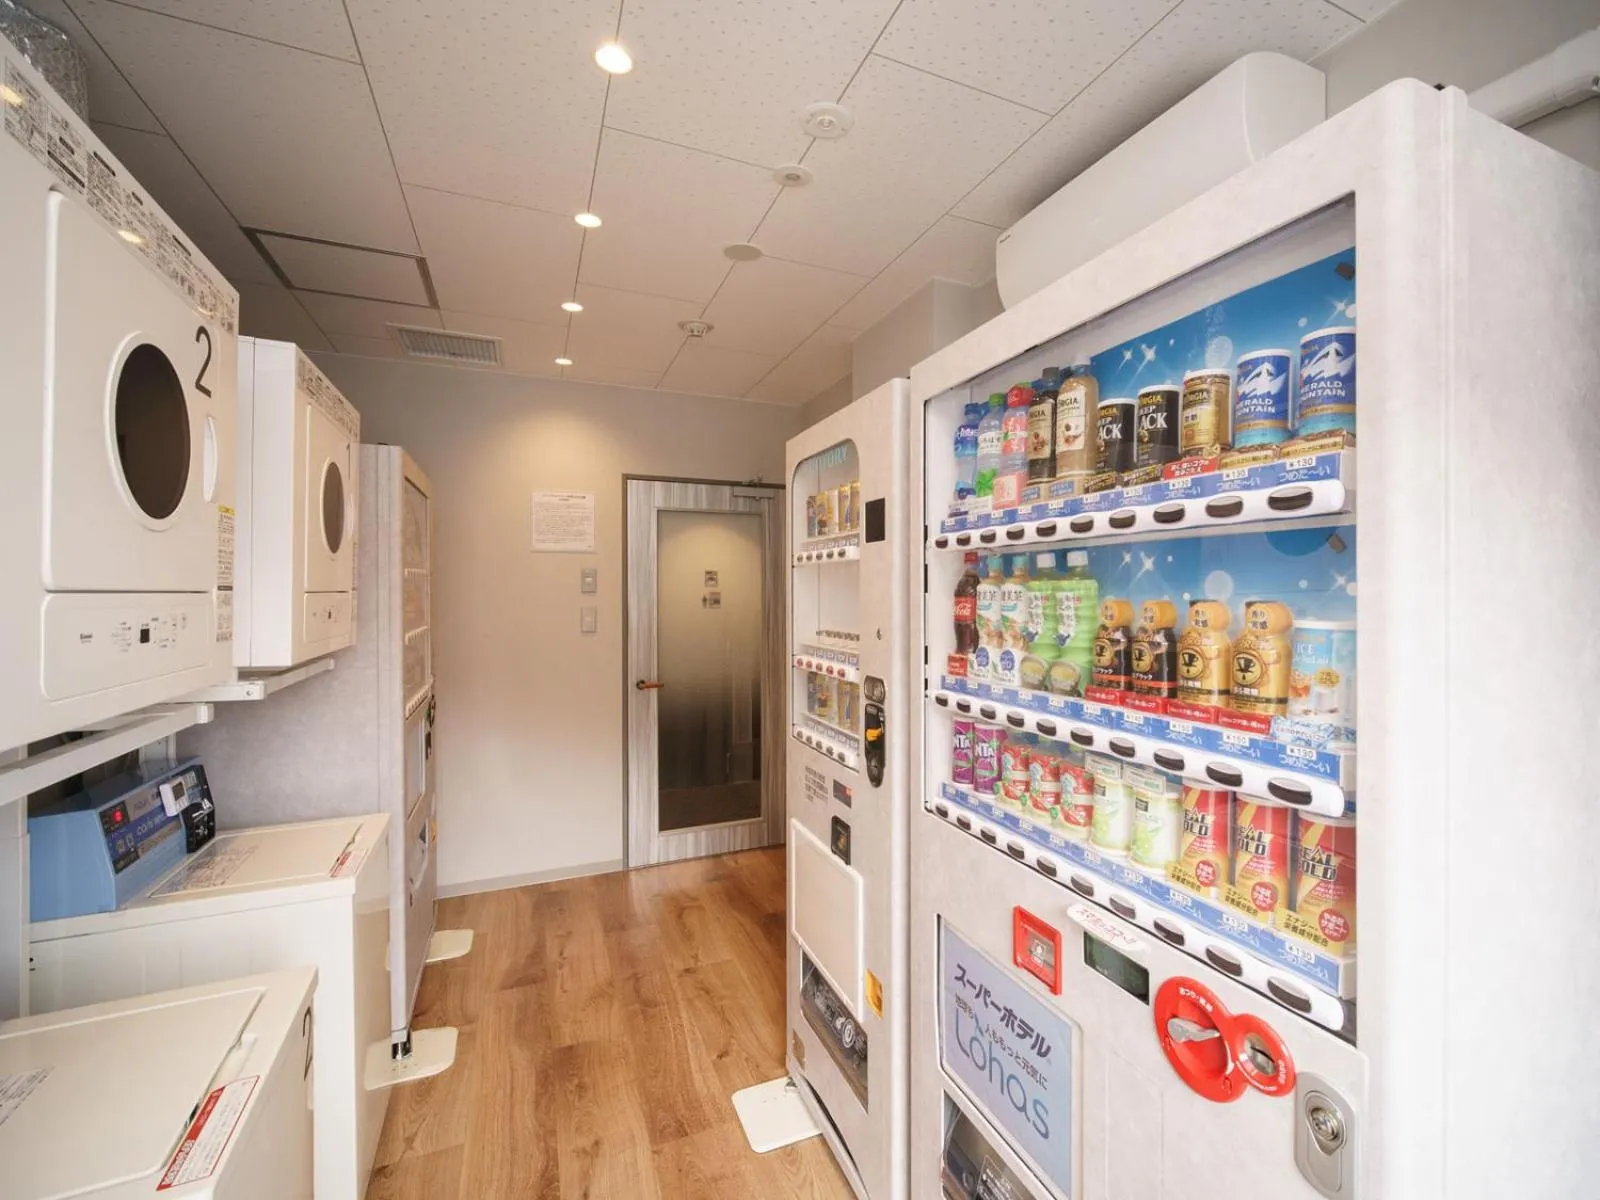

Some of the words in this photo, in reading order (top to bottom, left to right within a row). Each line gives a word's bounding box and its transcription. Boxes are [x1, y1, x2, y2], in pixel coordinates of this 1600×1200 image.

[195, 325, 212, 398] 2
[303, 1006, 313, 1081] 2
[954, 963, 1052, 1059] スーパーホテル
